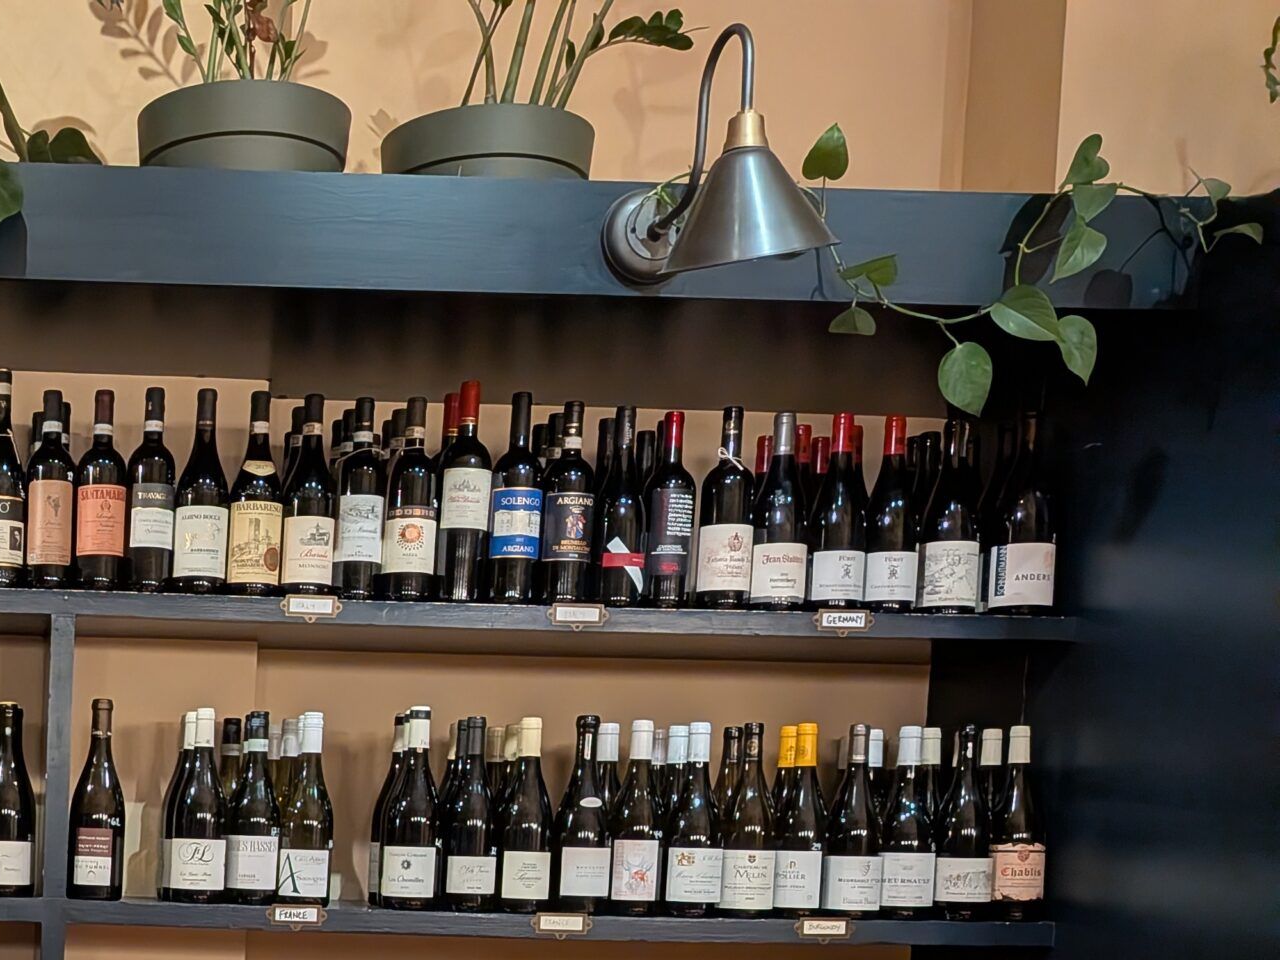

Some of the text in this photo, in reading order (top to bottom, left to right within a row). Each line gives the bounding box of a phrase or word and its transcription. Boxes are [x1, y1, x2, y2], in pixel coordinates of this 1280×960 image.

[501, 497, 541, 507] SOLENGO
[556, 496, 594, 506] ARGIANO
[502, 545, 534, 553] ARGIANO
[826, 613, 863, 625] GERMANY
[1001, 864, 1042, 878] Chablis
[279, 909, 308, 920] FRANCE
